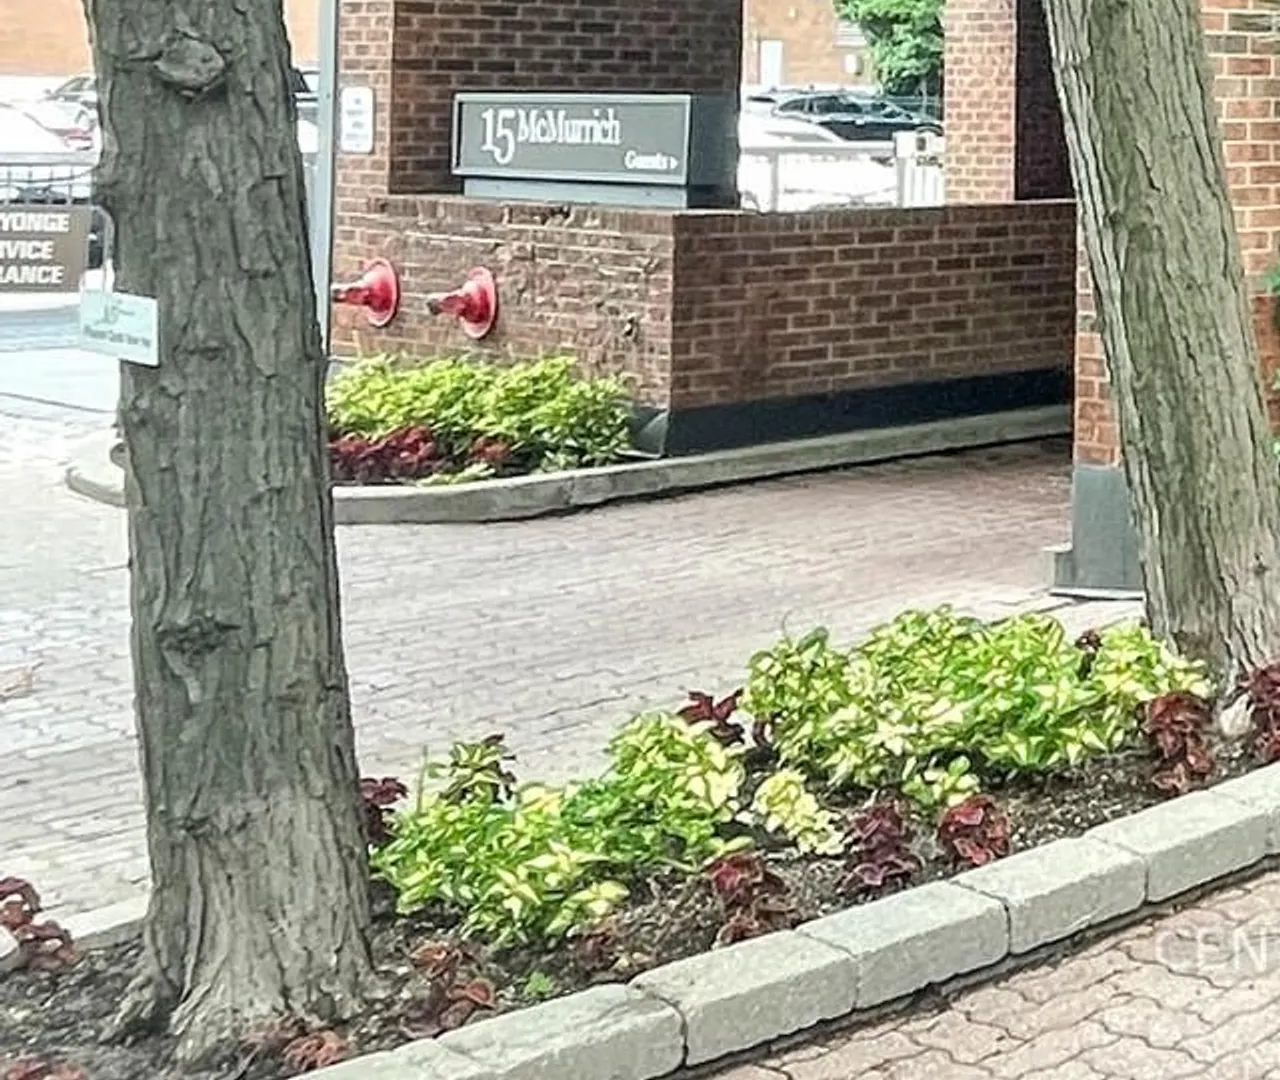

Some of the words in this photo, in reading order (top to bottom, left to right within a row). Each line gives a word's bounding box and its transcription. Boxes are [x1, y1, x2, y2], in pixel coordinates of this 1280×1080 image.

[481, 108, 516, 164] 15
[517, 107, 622, 145] McMurrich
[0, 212, 70, 233] YONGE
